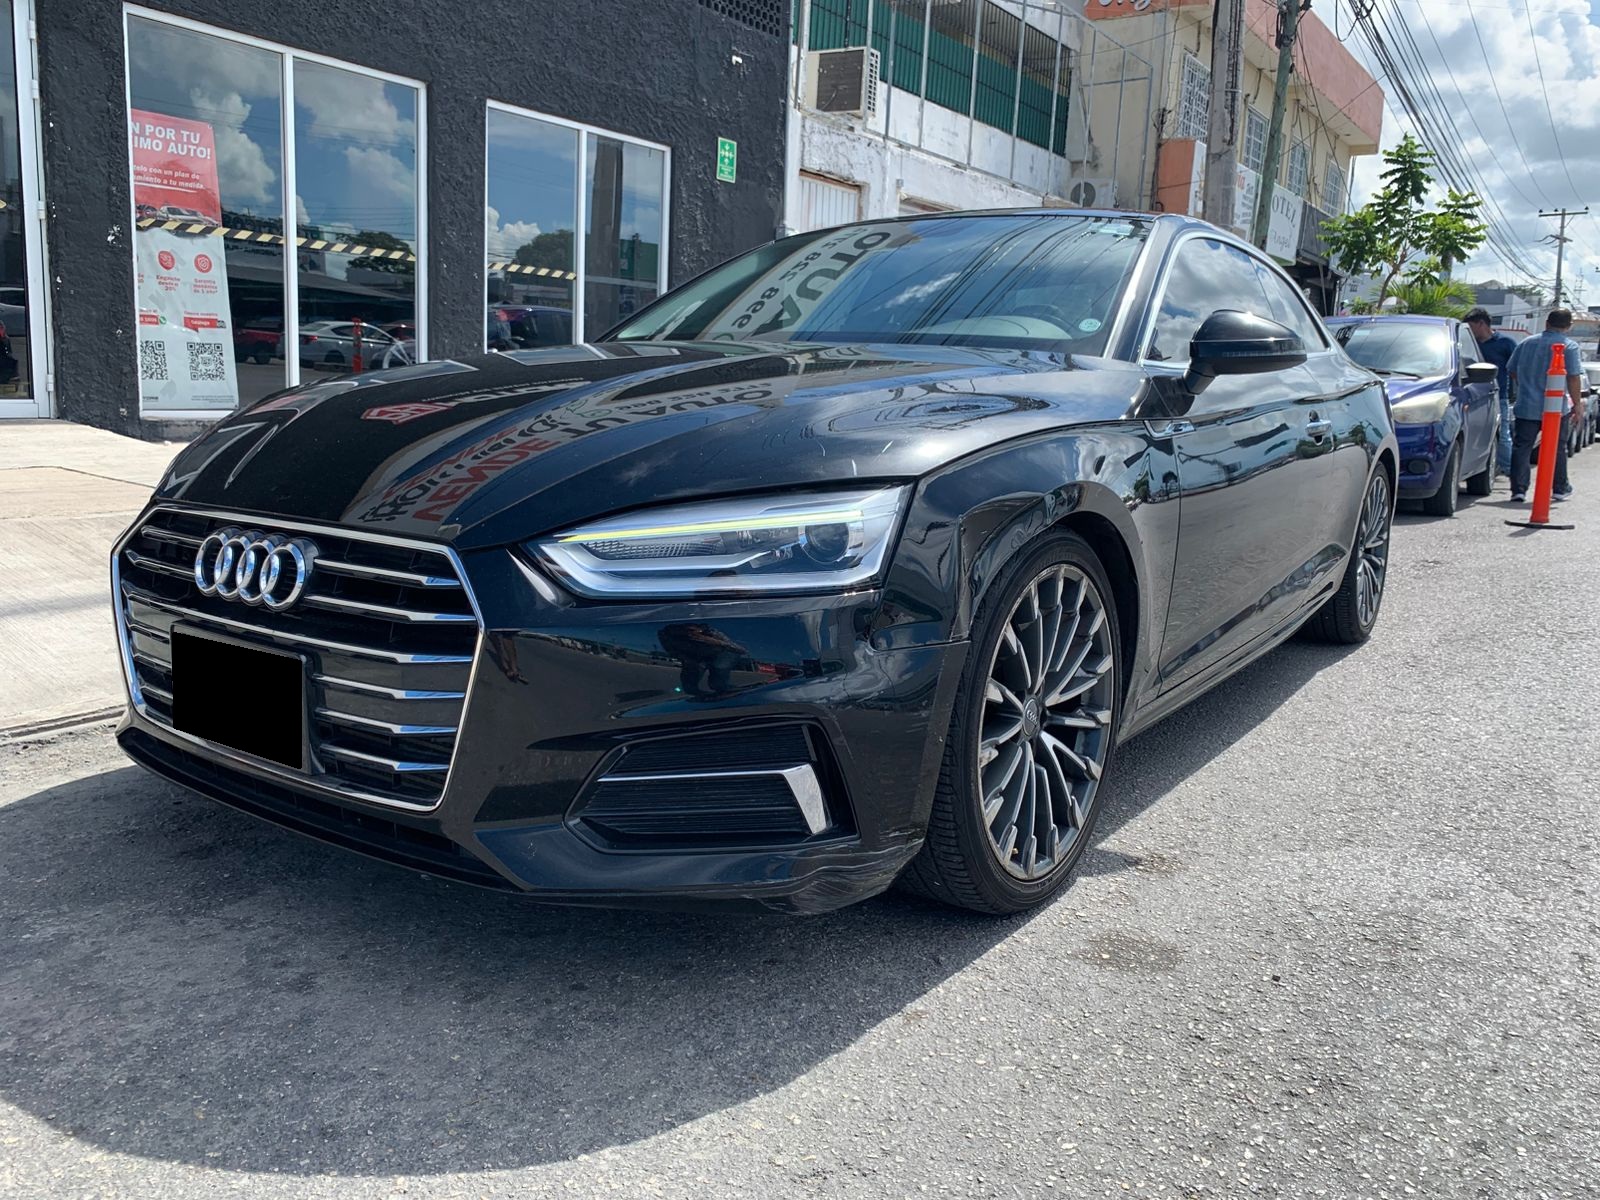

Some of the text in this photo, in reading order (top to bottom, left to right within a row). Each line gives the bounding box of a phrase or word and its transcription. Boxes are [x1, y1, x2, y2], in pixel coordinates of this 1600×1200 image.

[145, 124, 176, 141] POR
[181, 130, 200, 144] TU
[167, 142, 211, 160] AUTO!
[149, 167, 162, 175] con
[174, 170, 190, 178] plan
